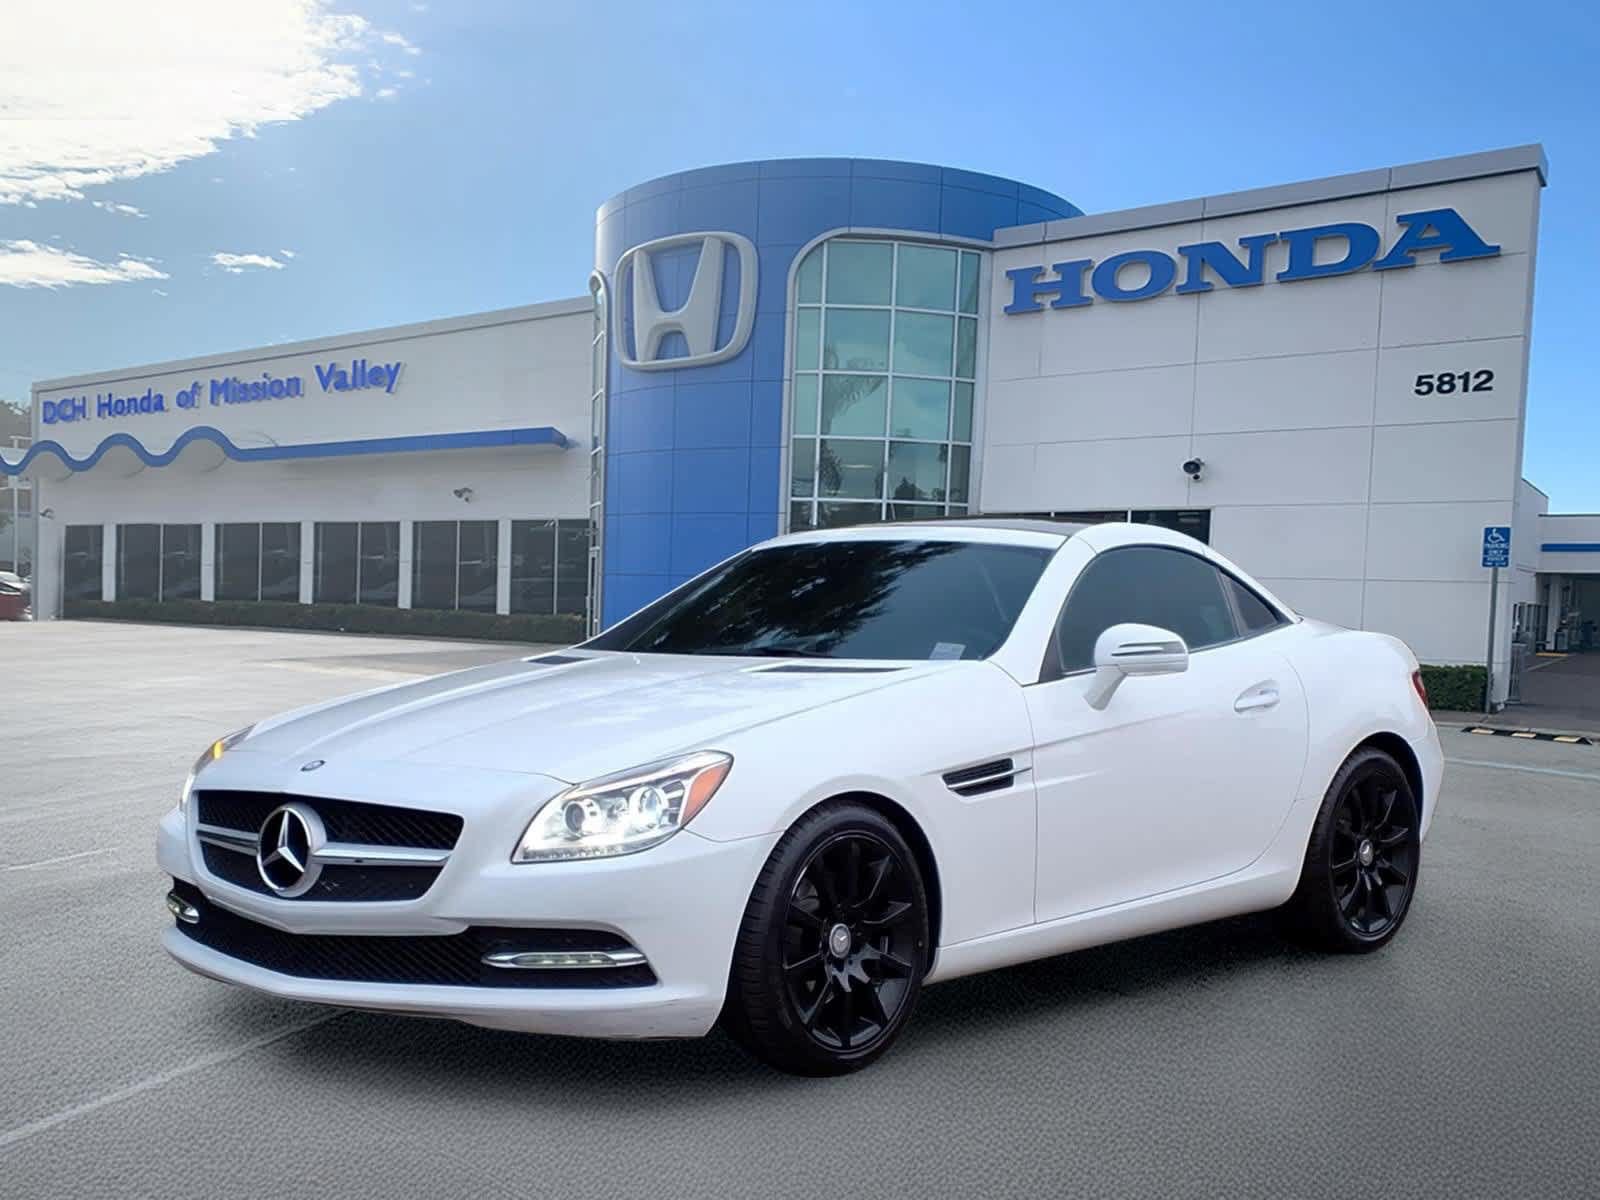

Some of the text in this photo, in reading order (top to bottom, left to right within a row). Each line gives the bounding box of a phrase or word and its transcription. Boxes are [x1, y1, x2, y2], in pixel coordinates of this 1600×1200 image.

[1003, 207, 1501, 316] HONDA
[42, 359, 402, 424] DCH Honda of Mission Valley
[1414, 369, 1495, 396] 5812
